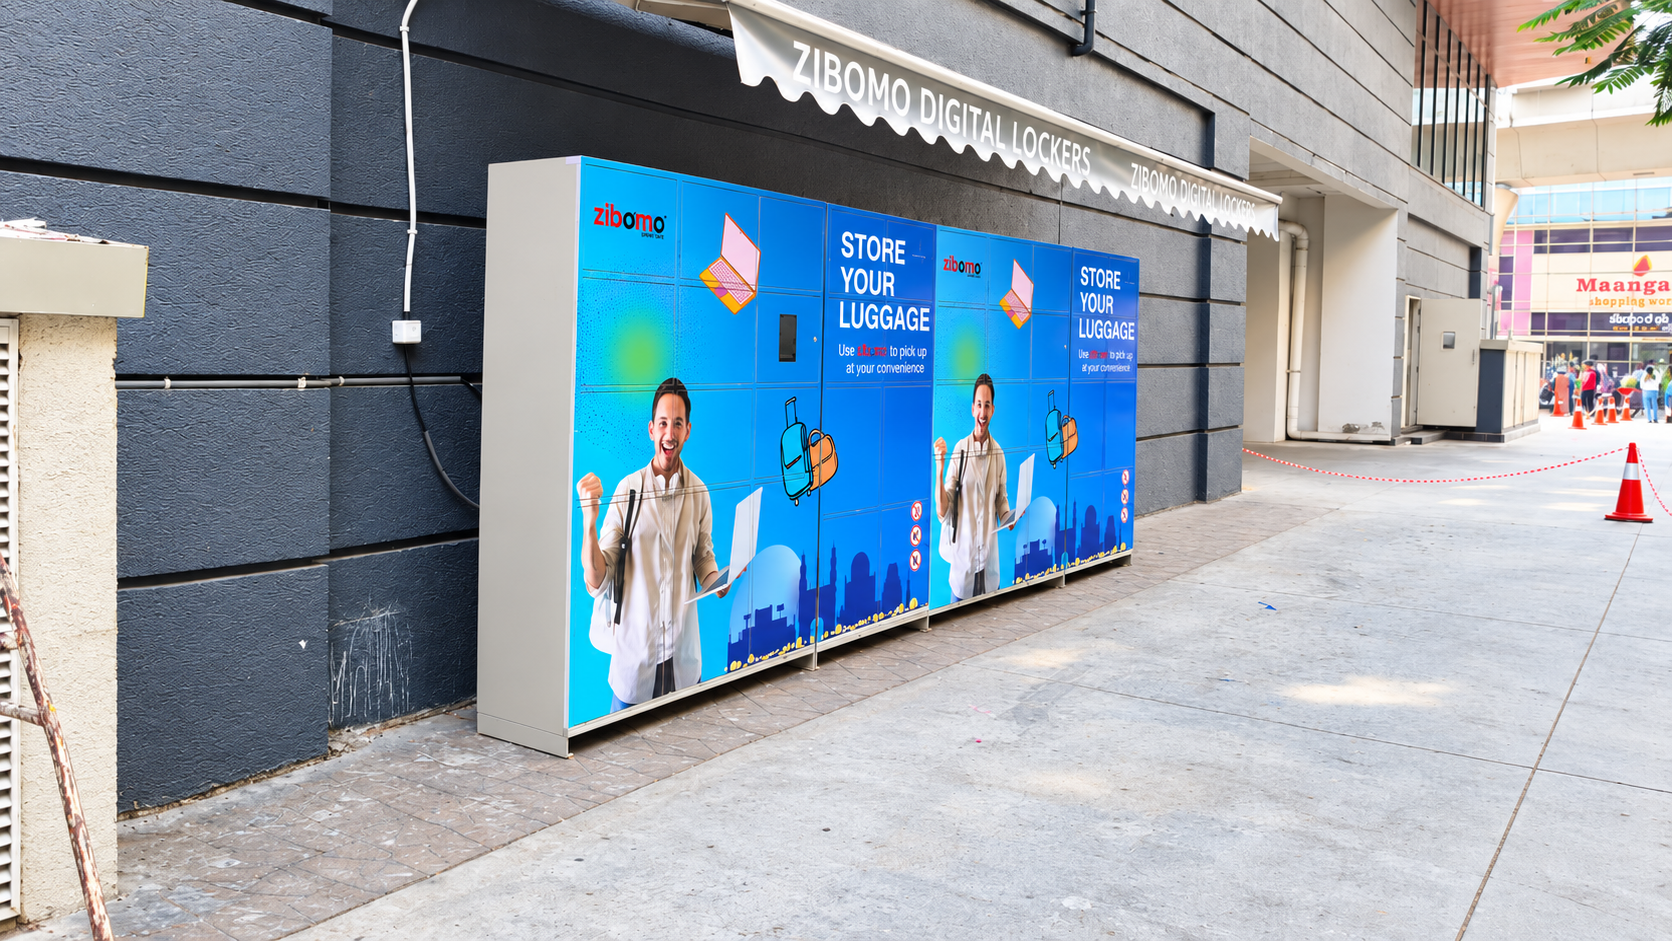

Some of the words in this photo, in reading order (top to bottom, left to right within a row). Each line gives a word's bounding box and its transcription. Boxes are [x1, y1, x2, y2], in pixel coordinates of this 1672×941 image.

[793, 40, 911, 117] ZIBOMO
[920, 87, 1006, 150] DIGITAL
[1012, 121, 1091, 176] LOCKERS
[1131, 162, 1177, 200] ZIBOMO
[1180, 179, 1218, 213] DIGITAL
[1220, 191, 1256, 221] LOCKERS
[593, 202, 667, 234] zibomo
[841, 231, 906, 266] STORE
[943, 255, 982, 275] zibomo
[840, 266, 895, 297] YOUR
[1080, 266, 1121, 290] STORE
[1576, 278, 1671, 295] Maanga
[1080, 292, 1114, 315] YOUR
[1589, 296, 1645, 308] shopping
[839, 301, 931, 332] LUGGAGE
[1078, 318, 1135, 341] LUGGAGE
[838, 343, 855, 357] Use
[889, 345, 898, 357] to
[899, 344, 916, 360] pick
[917, 347, 927, 360] up
[846, 362, 855, 374] at
[856, 364, 875, 377] your
[876, 361, 925, 374] convenience
